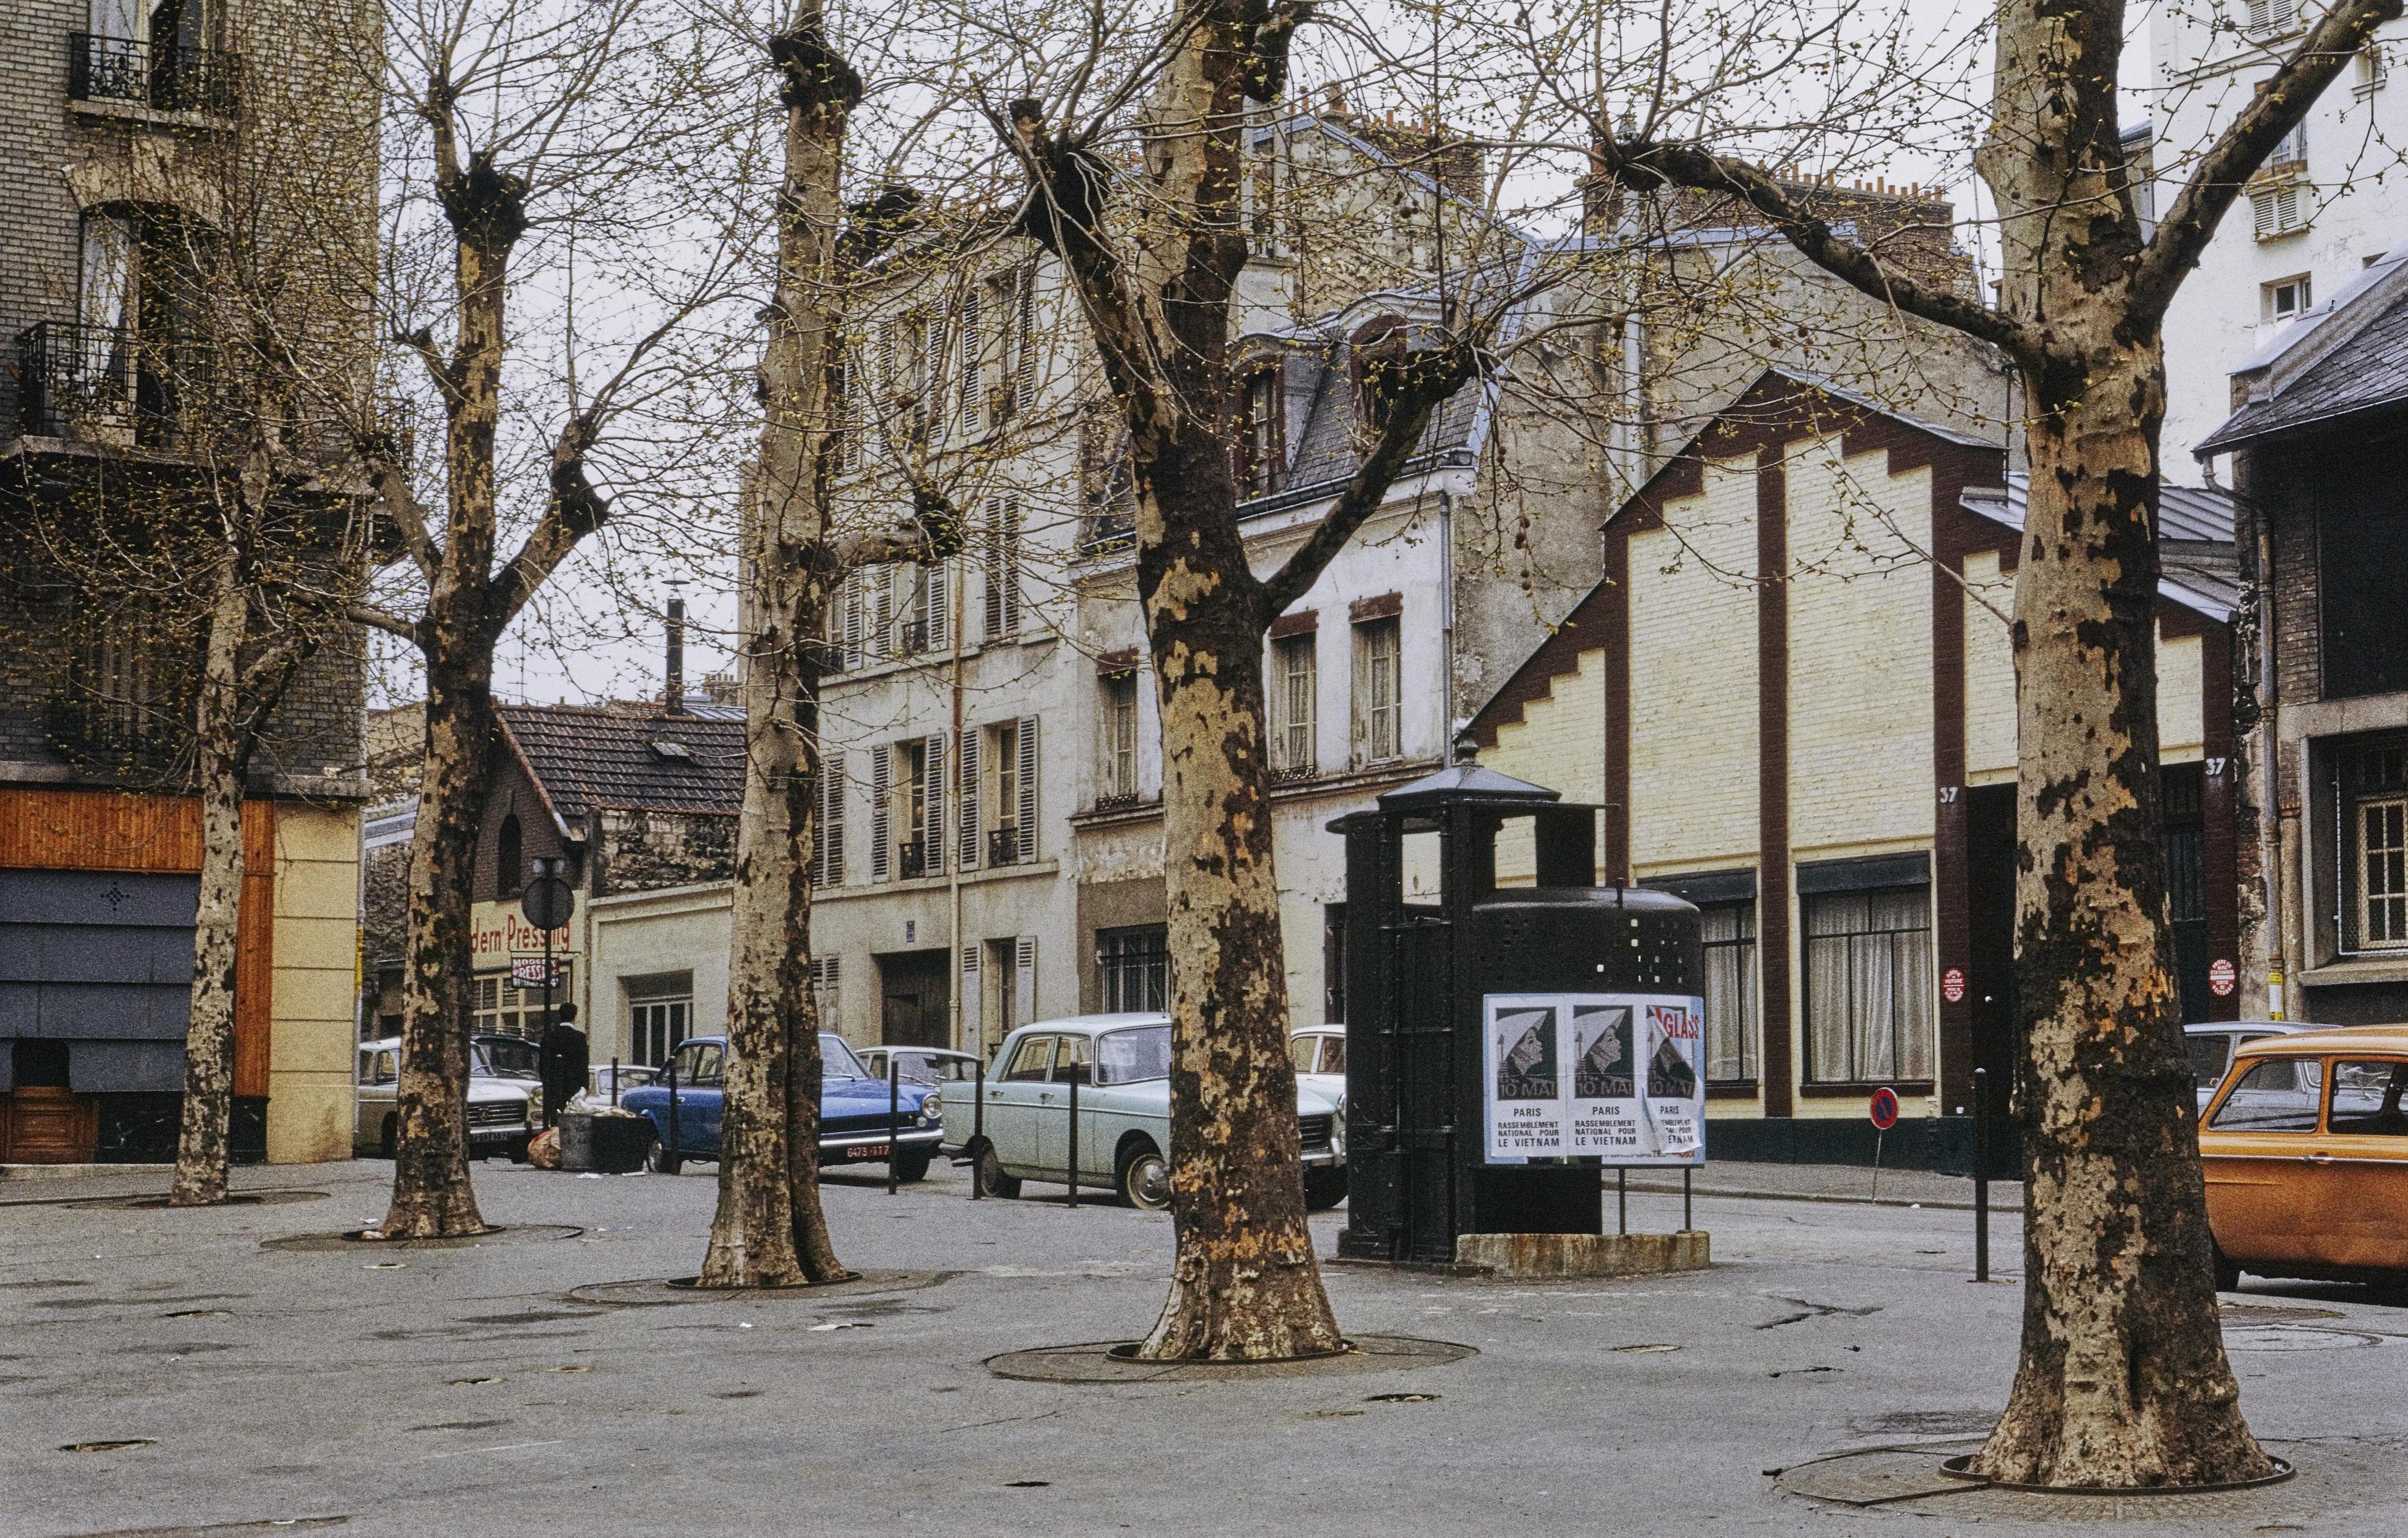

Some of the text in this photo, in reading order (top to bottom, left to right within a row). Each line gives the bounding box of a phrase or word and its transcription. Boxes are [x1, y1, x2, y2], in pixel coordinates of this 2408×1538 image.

[2205, 758, 2226, 775] 37
[1940, 787, 1958, 803] 37
[508, 914, 570, 954] Pressng
[513, 965, 558, 980] PRESSIG
[1499, 1082, 1555, 1097] 10 MAI
[1577, 1081, 1632, 1095] 10 MAI
[1650, 1081, 1663, 1094] 10
[1514, 1108, 1541, 1116] PARIS
[1592, 1106, 1620, 1115] PARIS
[1660, 1106, 1679, 1115] PARIS
[1498, 1138, 1559, 1147] LE VIETNAM
[1576, 1136, 1636, 1145] LE VIETNAM
[1668, 1134, 1693, 1144] ETNAM
